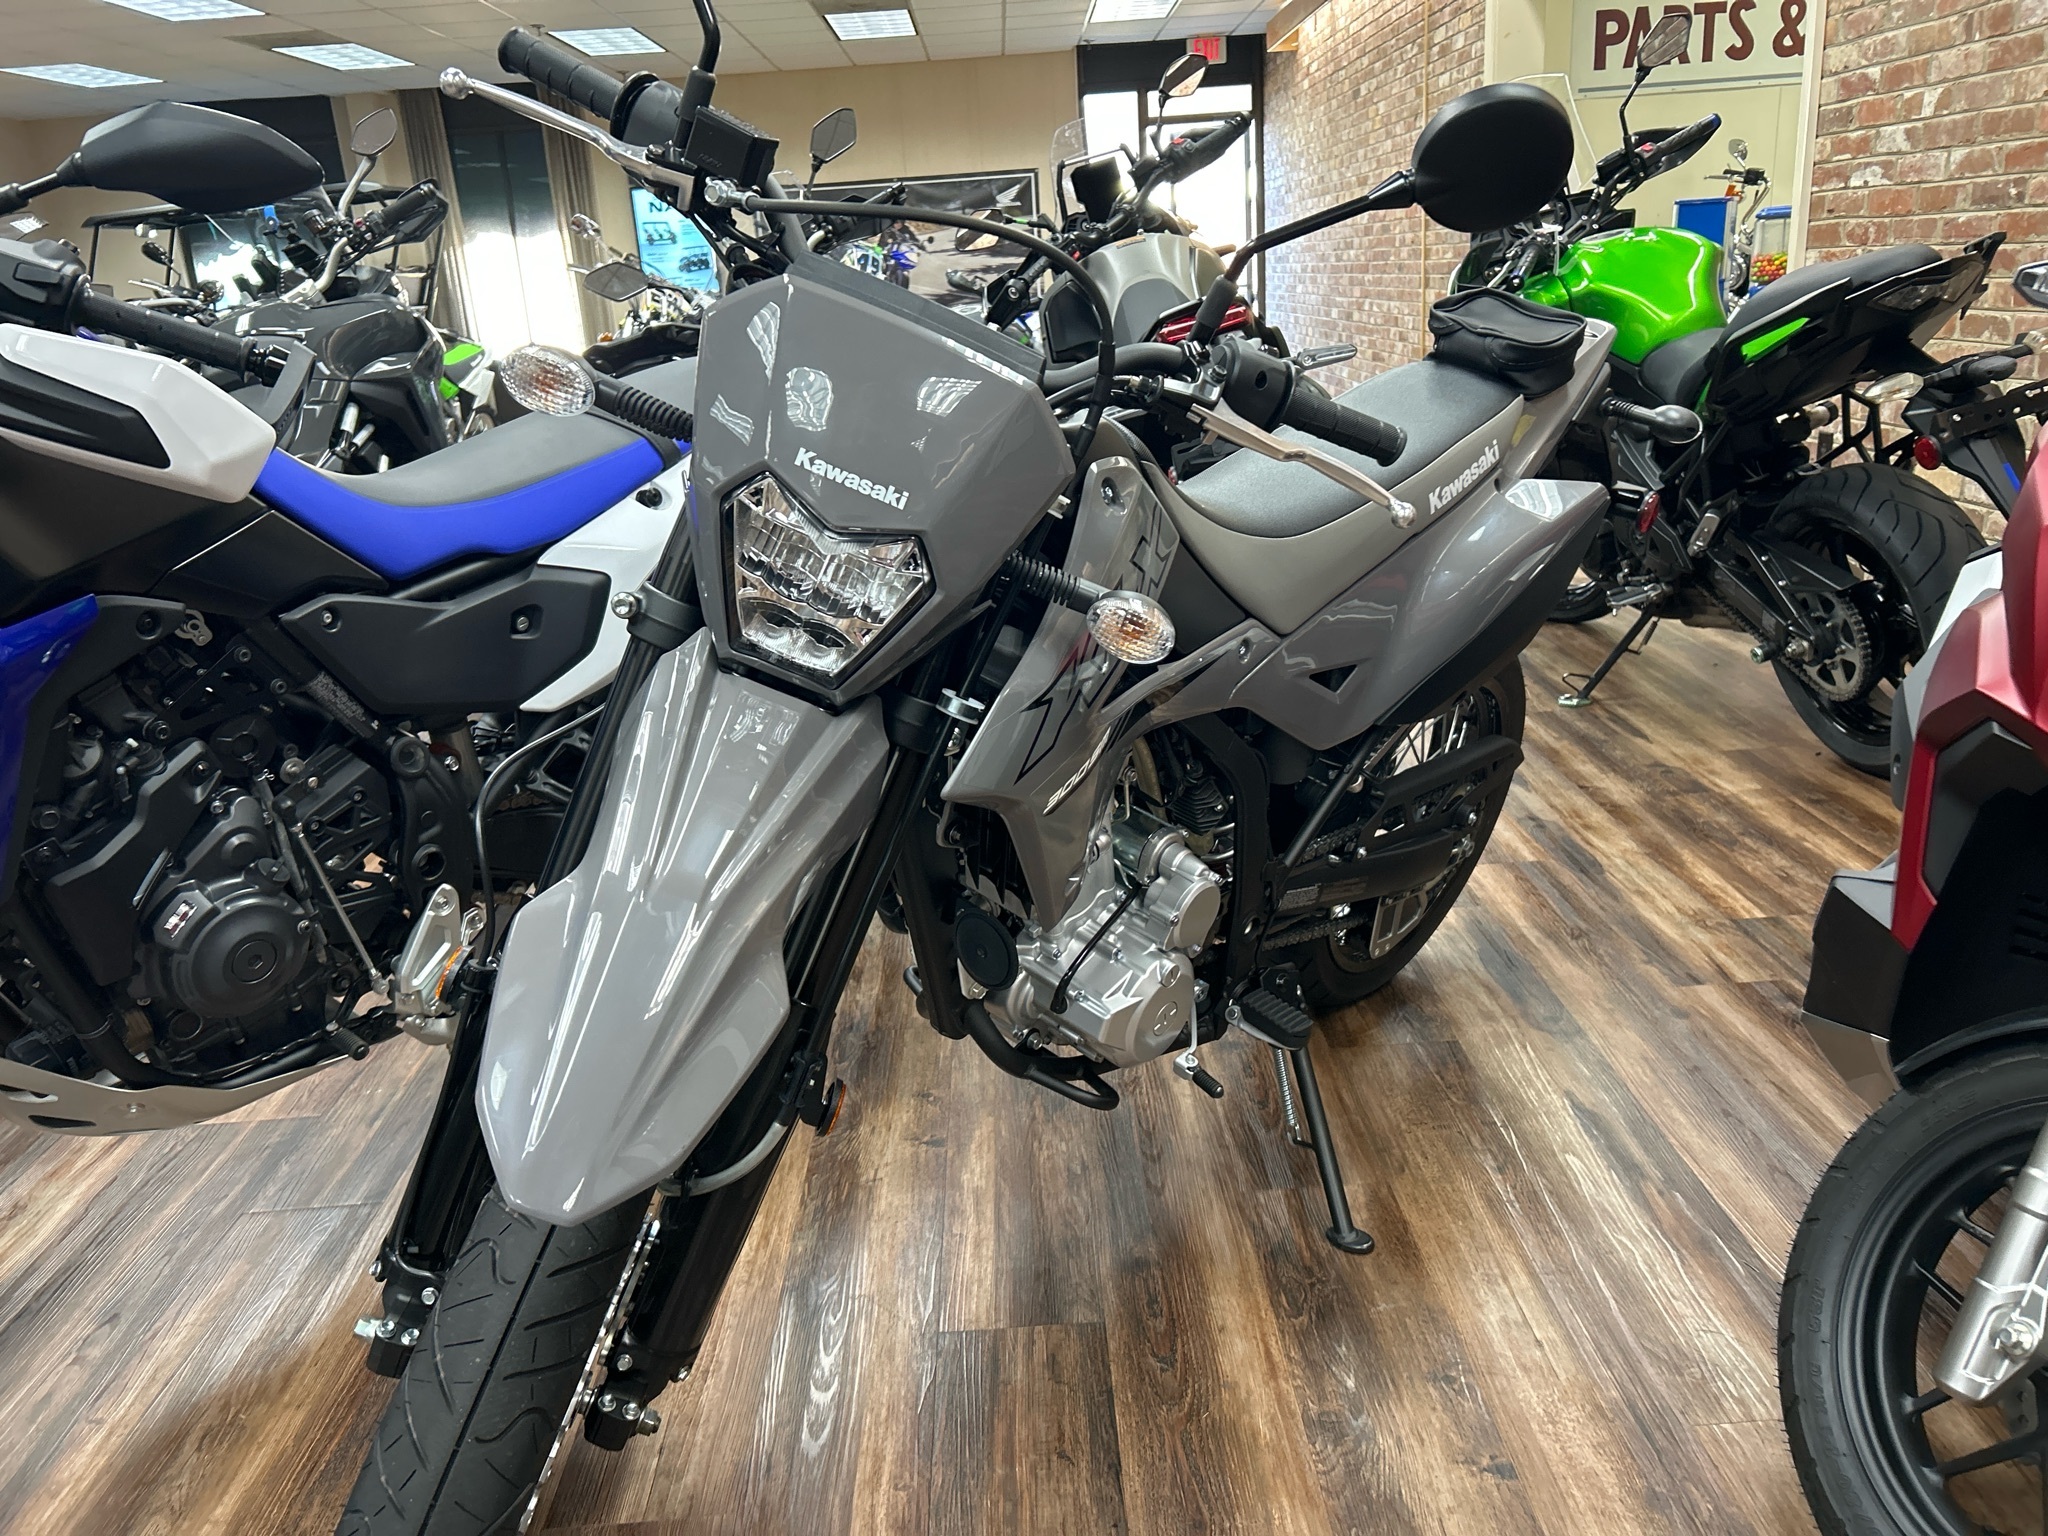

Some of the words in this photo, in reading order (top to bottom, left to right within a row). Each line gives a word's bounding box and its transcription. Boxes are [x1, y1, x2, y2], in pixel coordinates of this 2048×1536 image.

[1193, 37, 1221, 61] EXIT
[1772, 0, 1807, 58] &
[794, 447, 910, 511] Kawasaki
[1428, 439, 1500, 515] Kawasaki
